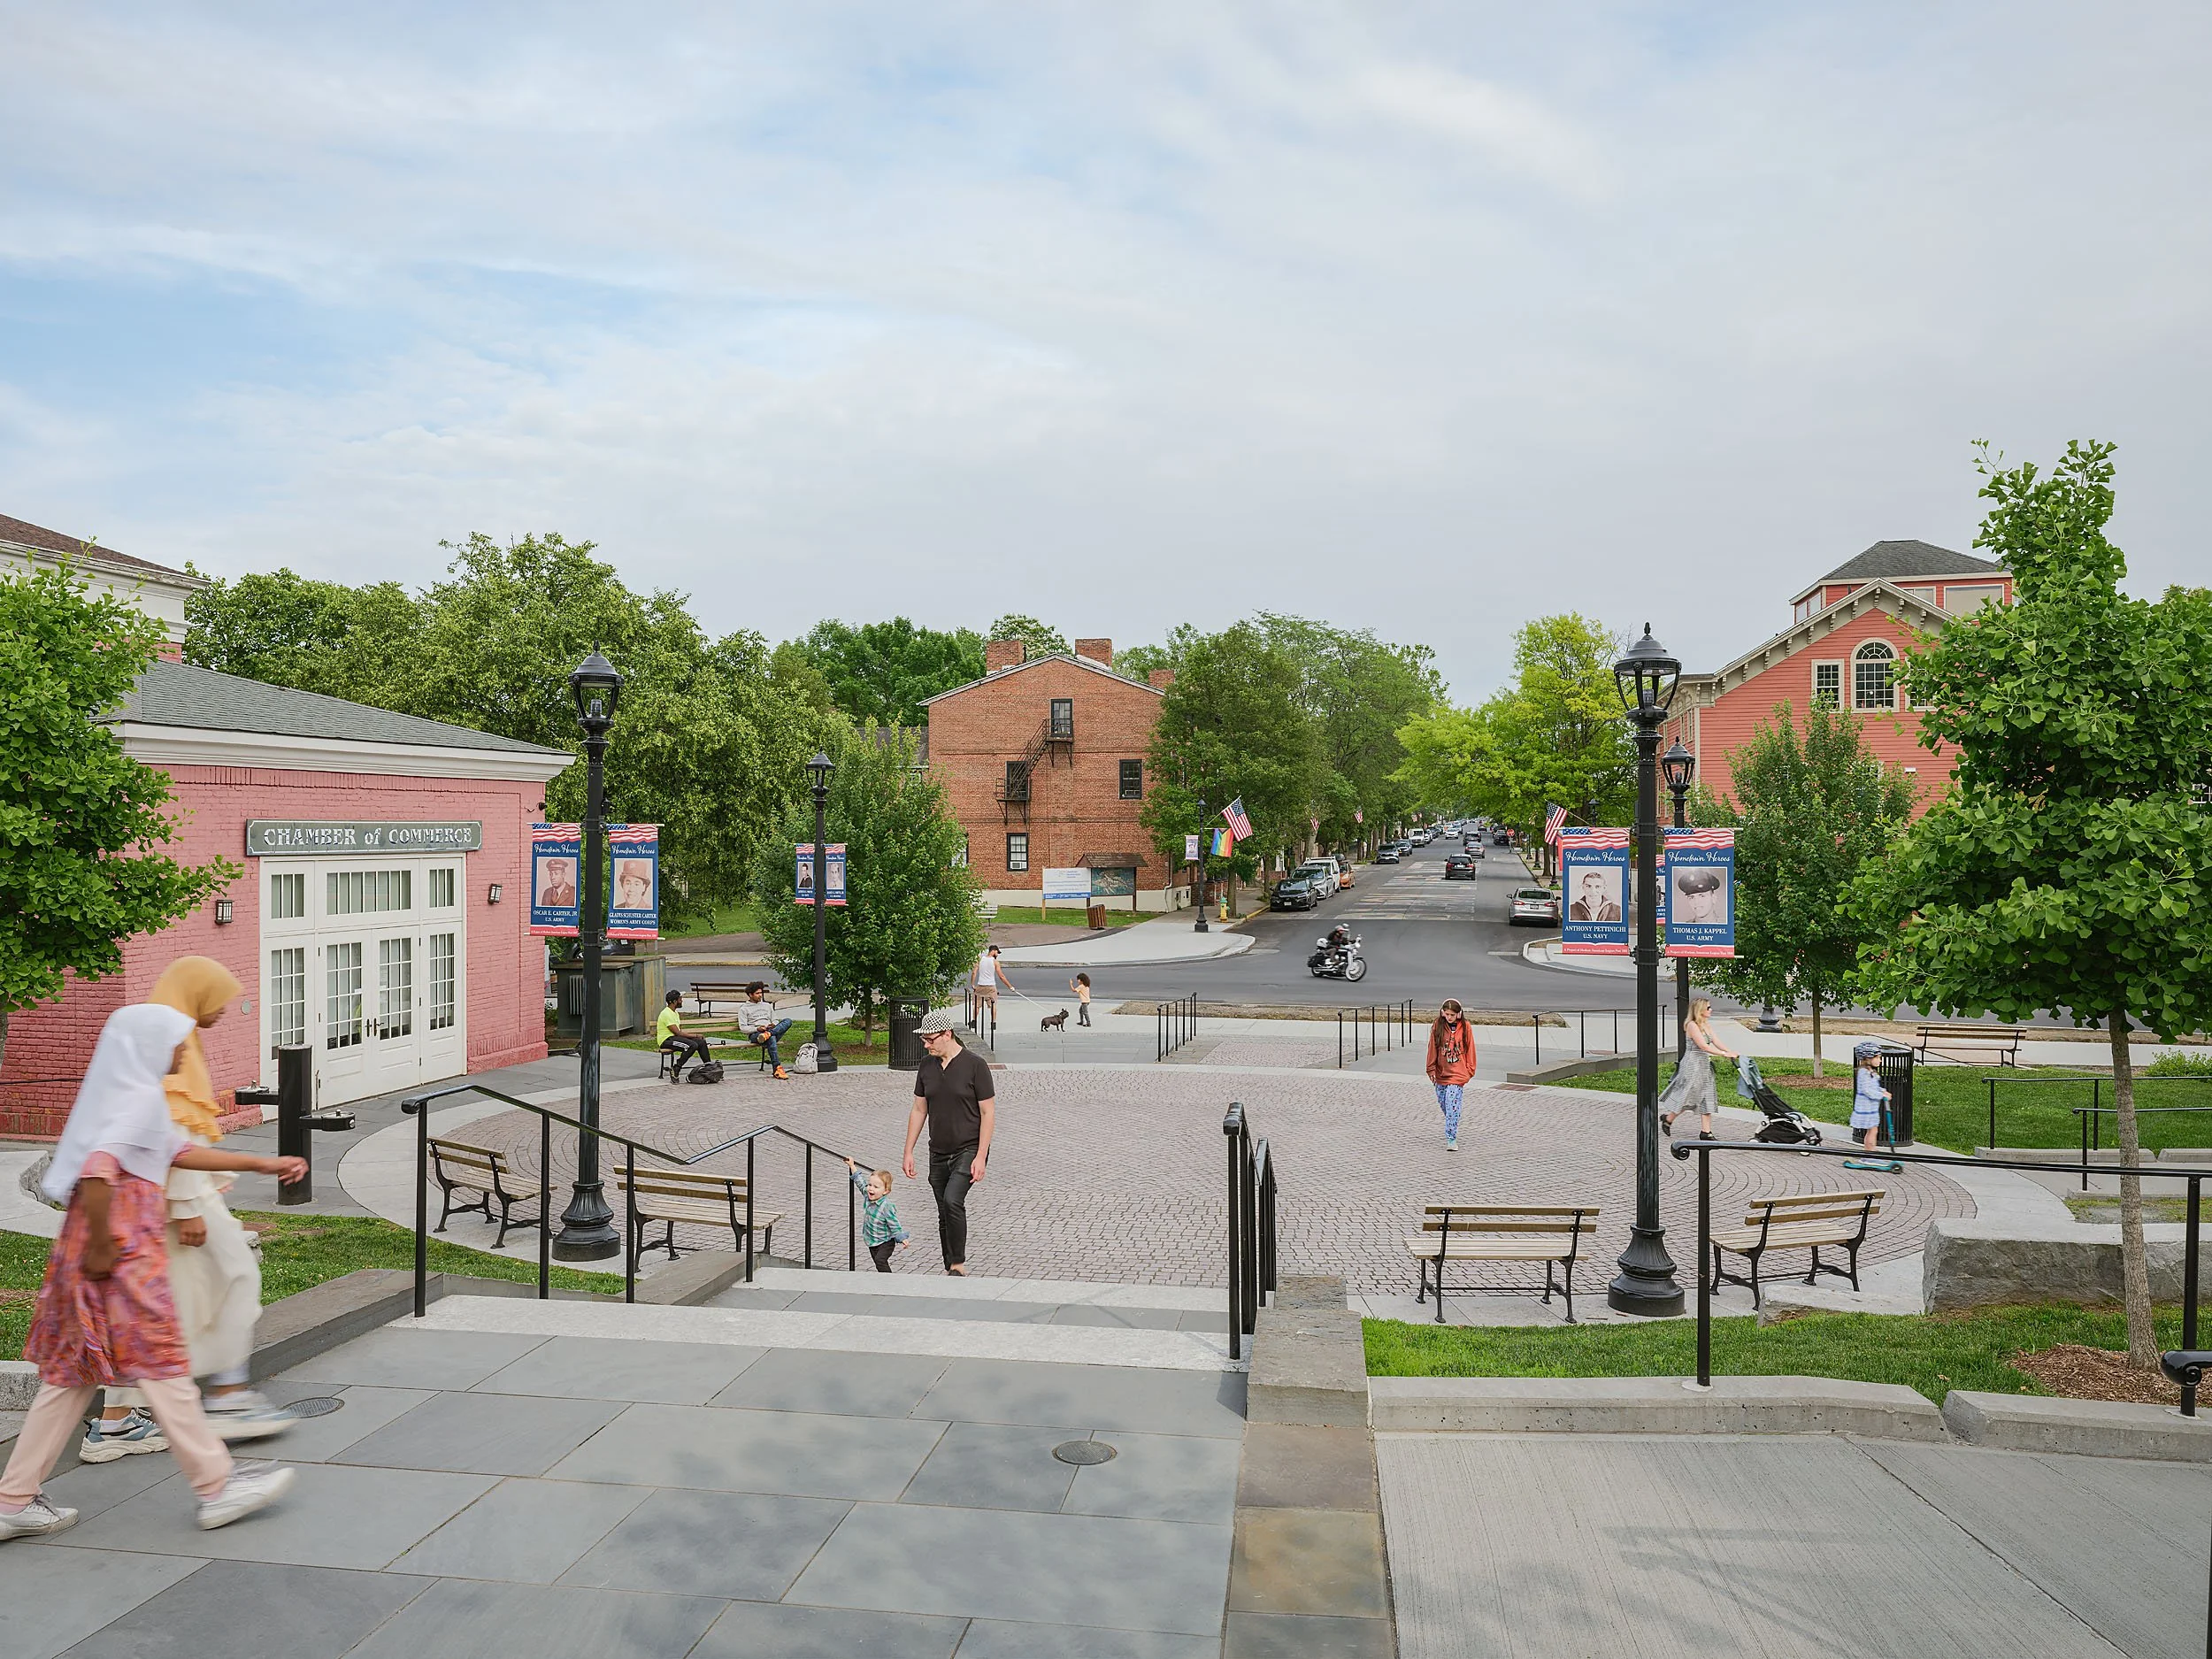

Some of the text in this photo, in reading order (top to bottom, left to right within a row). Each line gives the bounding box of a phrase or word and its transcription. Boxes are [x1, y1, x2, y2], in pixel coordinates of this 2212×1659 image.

[264, 827, 472, 845] CHAMBER of COMMERCE
[1565, 851, 1625, 862] Hometown Heroes
[1668, 851, 1731, 863] Hometown Heroes
